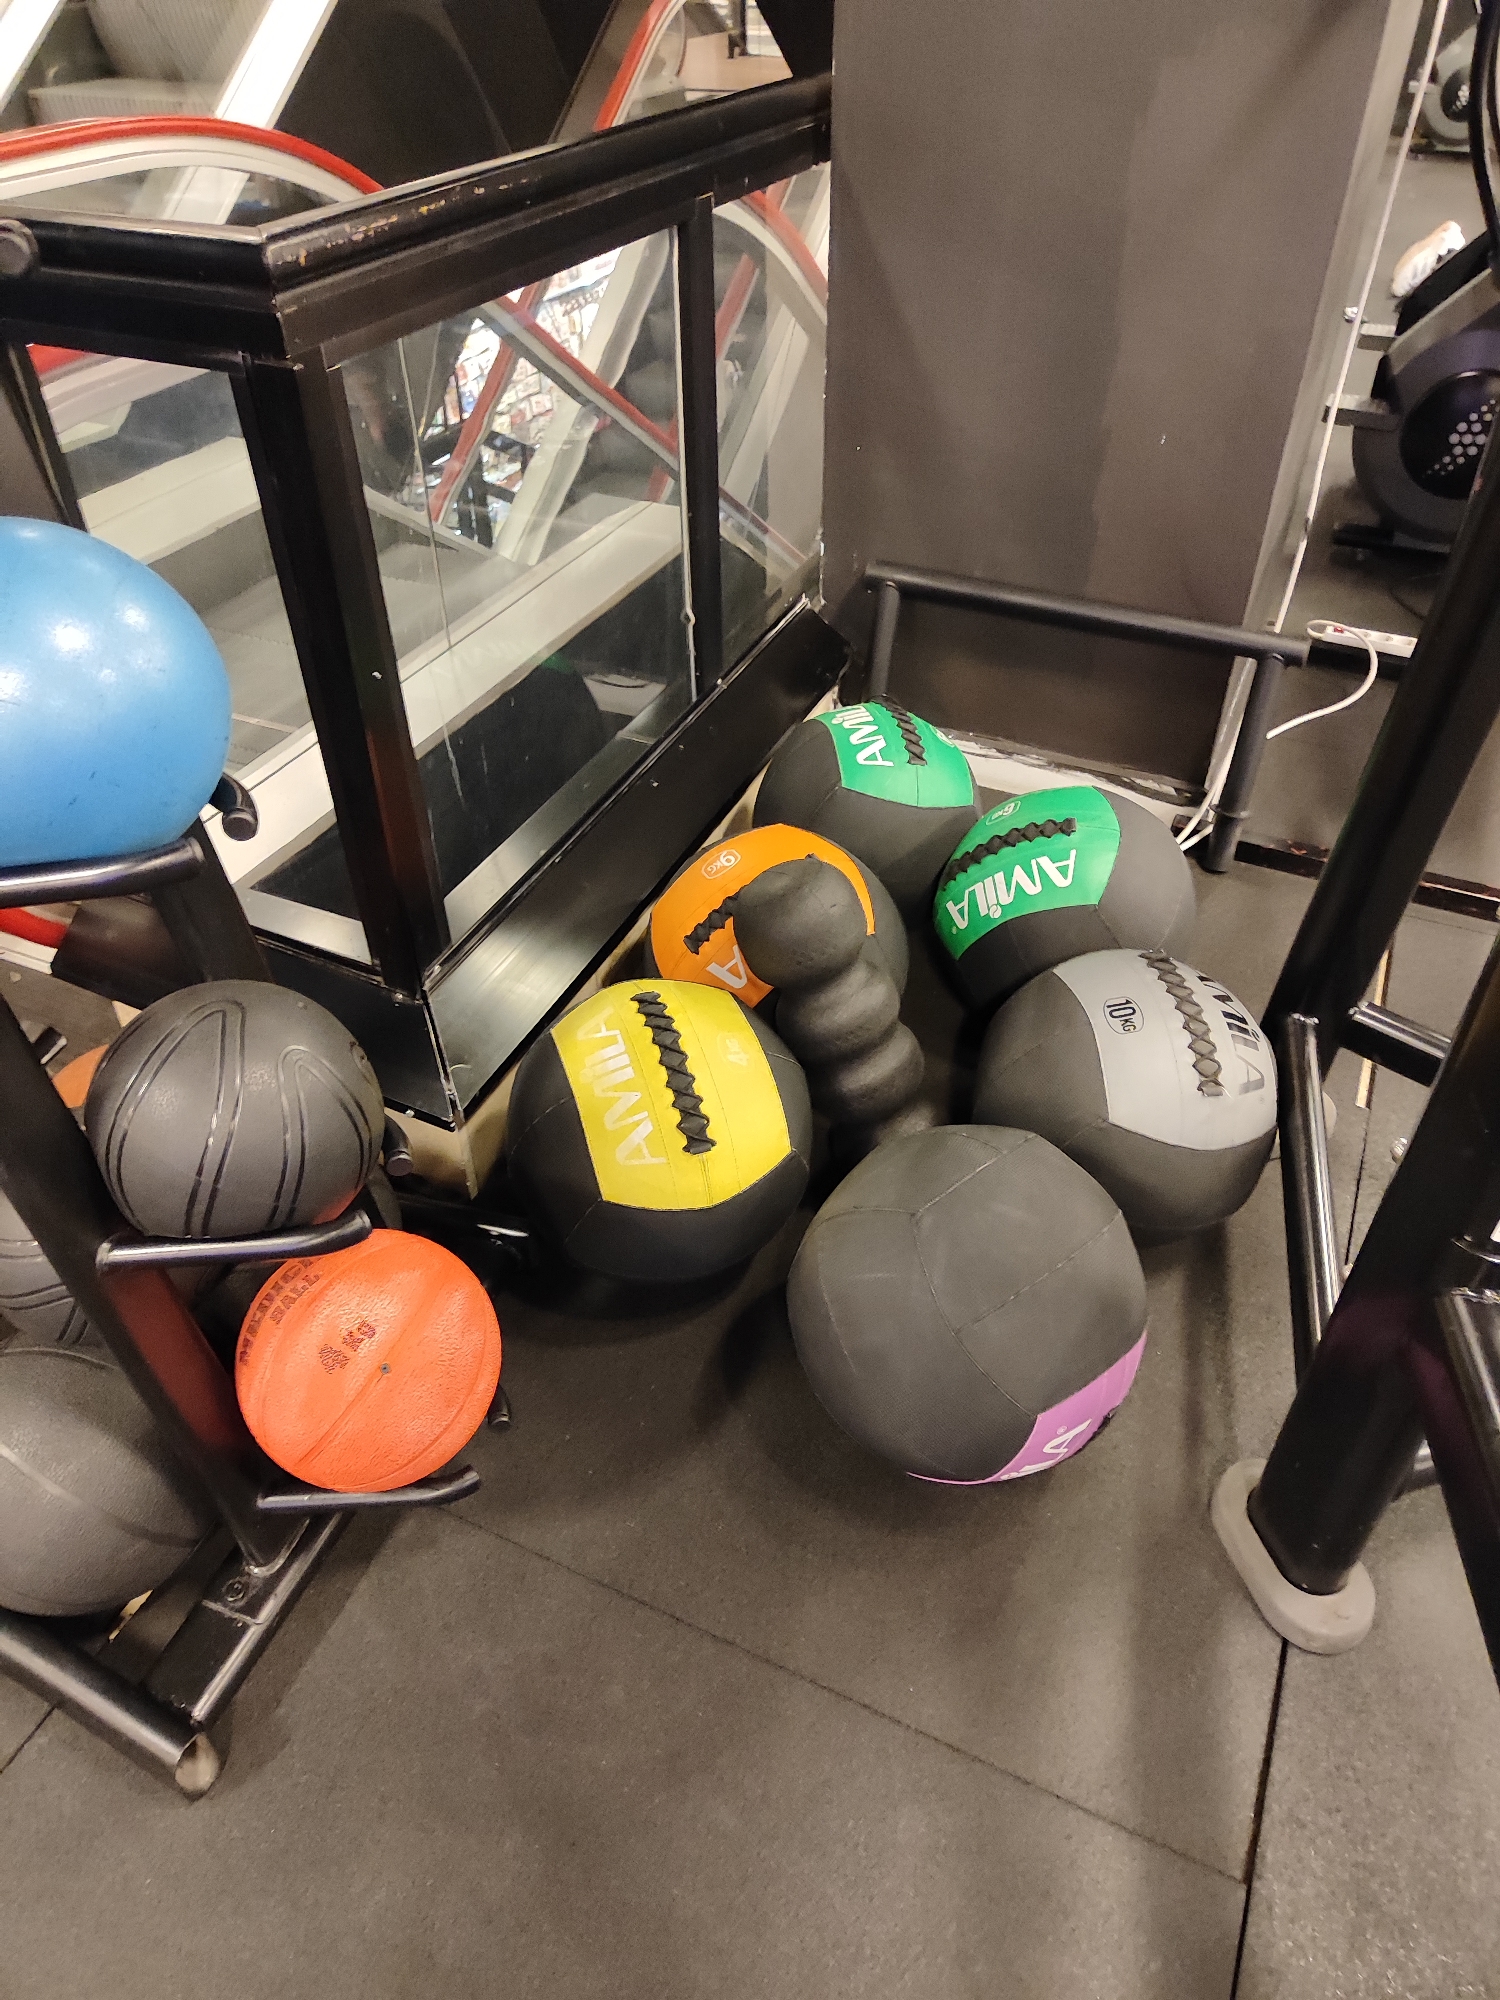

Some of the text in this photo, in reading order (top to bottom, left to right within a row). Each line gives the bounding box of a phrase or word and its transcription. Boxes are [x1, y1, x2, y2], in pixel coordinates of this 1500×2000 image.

[830, 704, 894, 767] AMiL
[706, 849, 736, 874] 9KG
[1106, 999, 1136, 1033] 10KG
